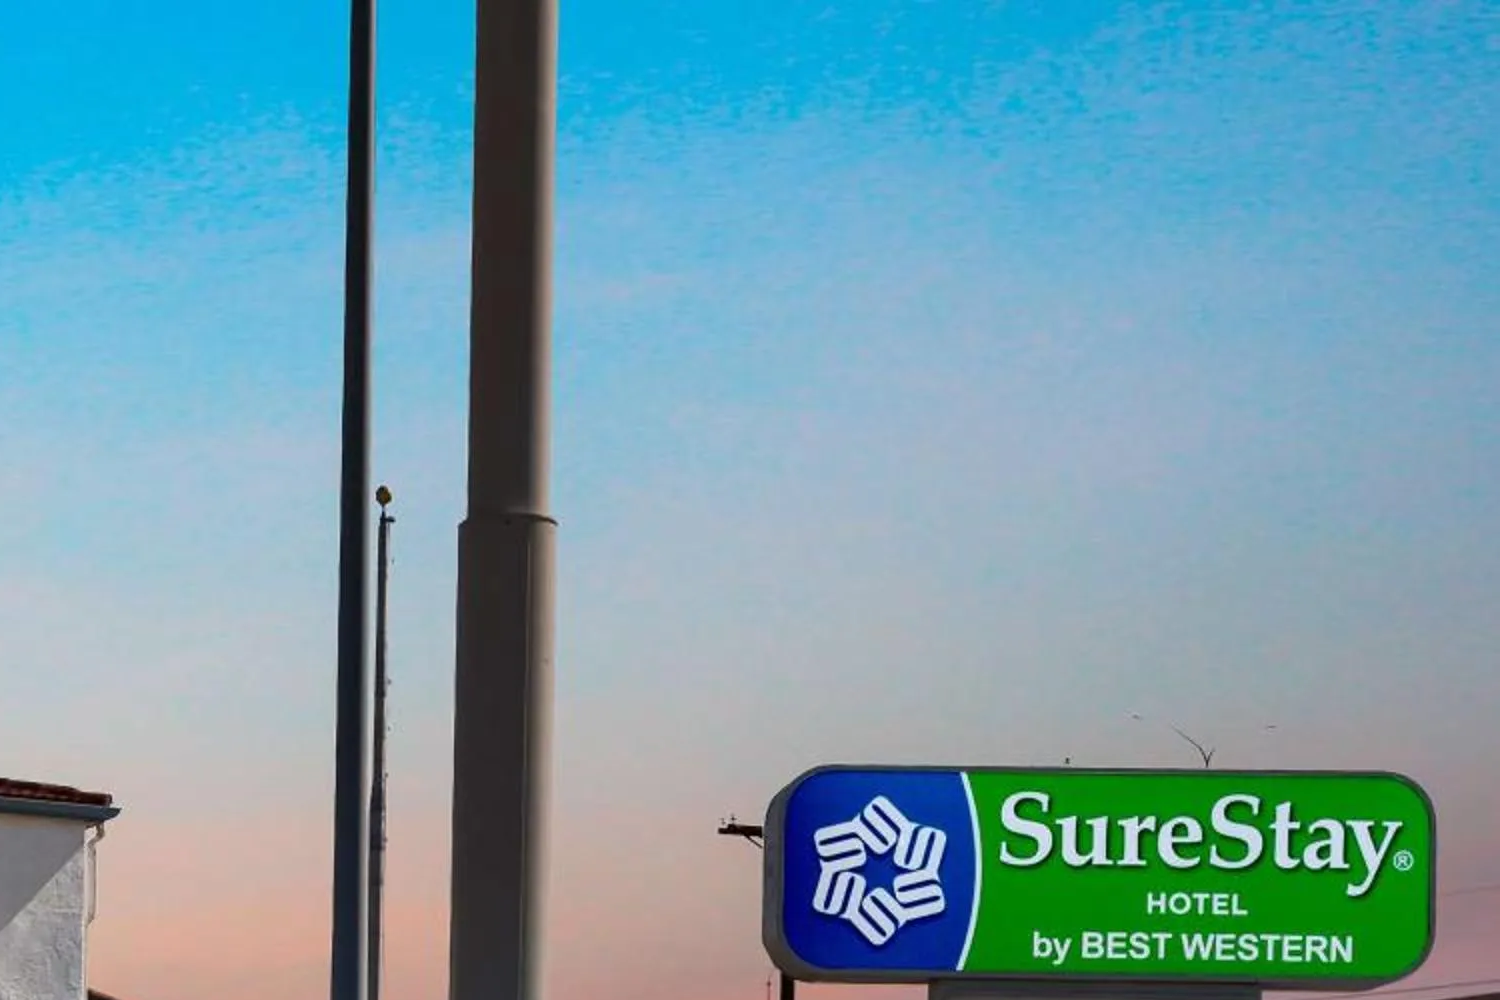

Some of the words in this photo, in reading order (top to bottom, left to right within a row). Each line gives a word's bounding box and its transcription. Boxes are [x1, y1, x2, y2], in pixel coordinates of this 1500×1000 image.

[1147, 892, 1248, 915] HOTEL
[1033, 931, 1072, 965] by
[1081, 931, 1173, 959] BEST
[1181, 933, 1353, 963] WESTERN
